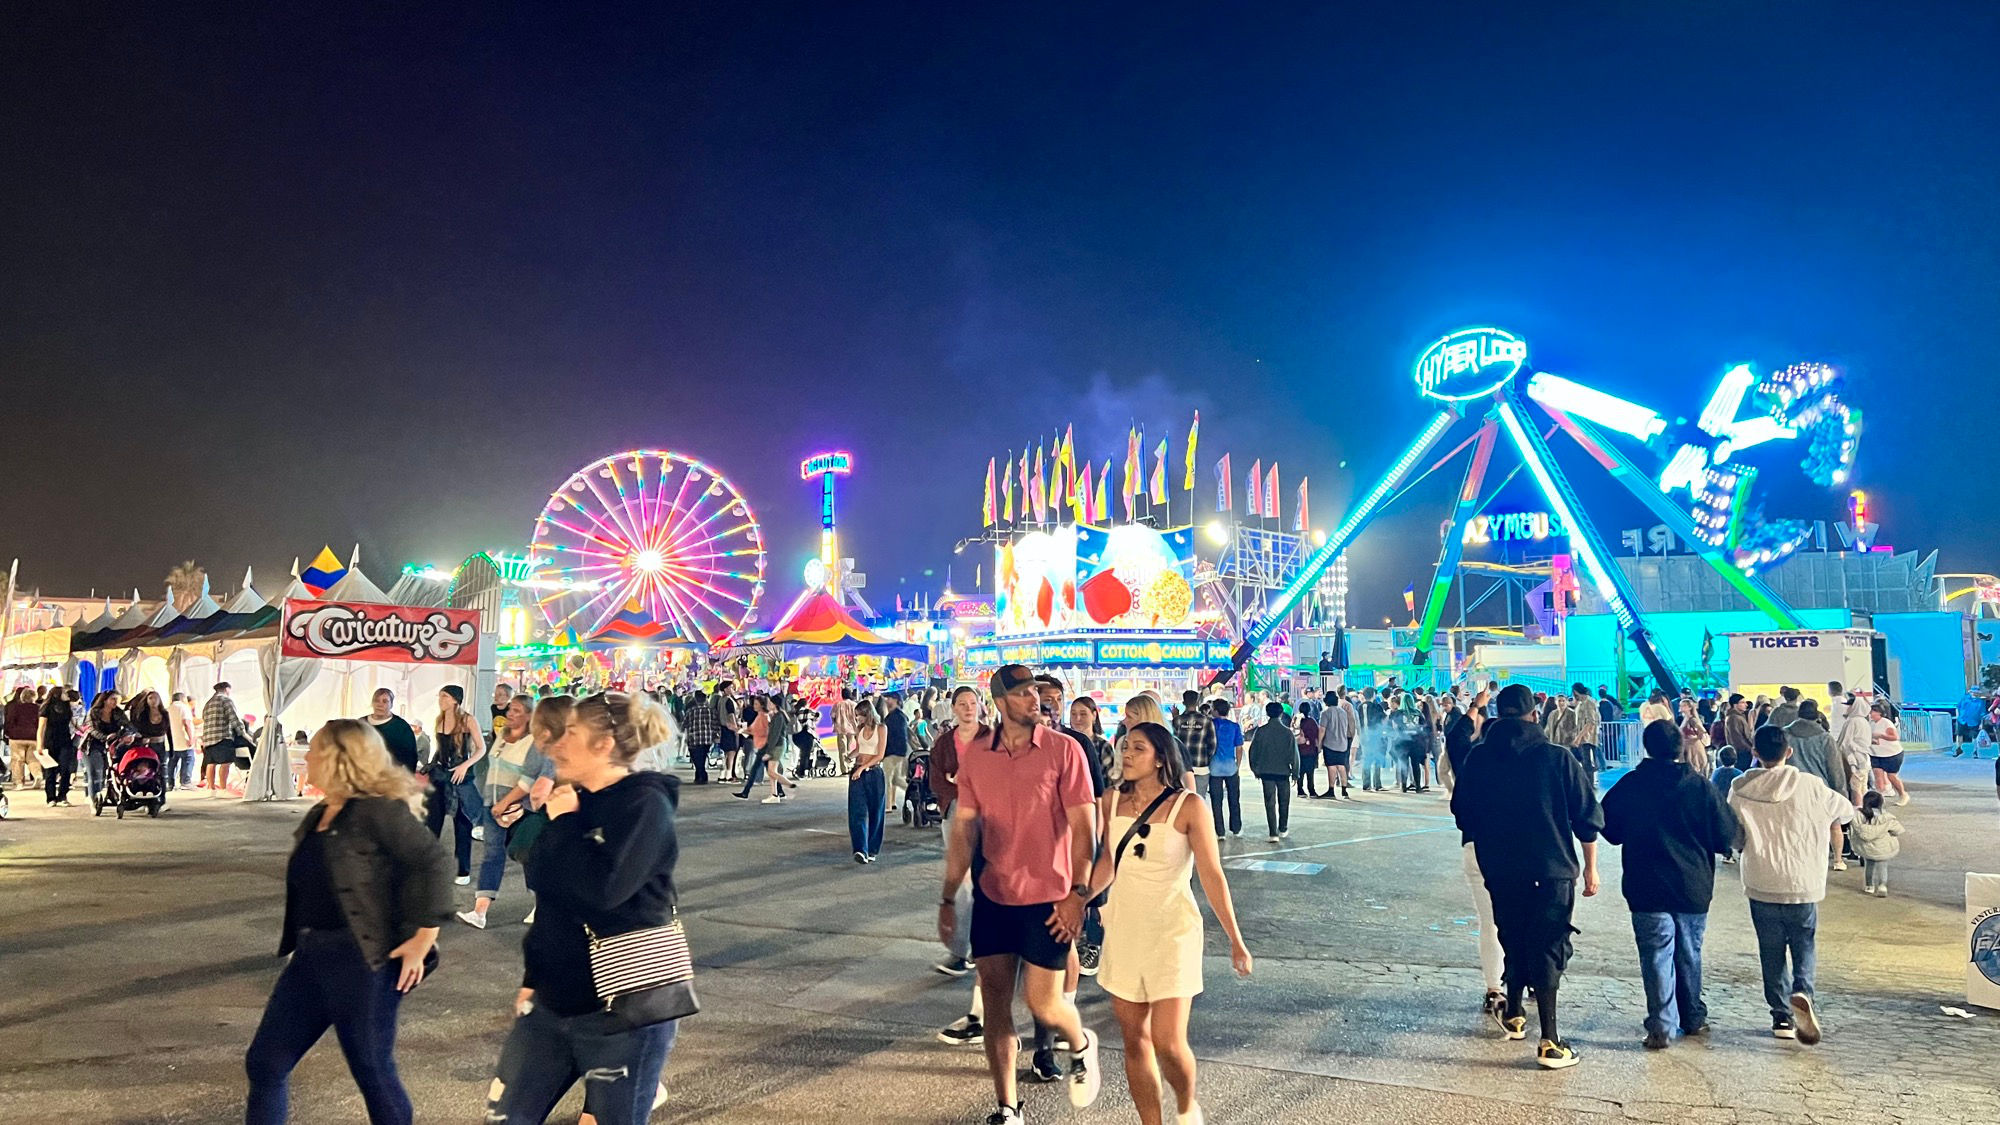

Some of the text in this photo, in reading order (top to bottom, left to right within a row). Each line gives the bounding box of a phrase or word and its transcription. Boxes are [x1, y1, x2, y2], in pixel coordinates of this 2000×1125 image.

[1422, 335, 1527, 397] HYPER LOOP
[1750, 636, 1820, 648] TICKETS
[1845, 635, 1868, 647] TICKETS
[1101, 644, 1202, 659] COTTON CANDY
[1970, 906, 2000, 926] VENTUR
